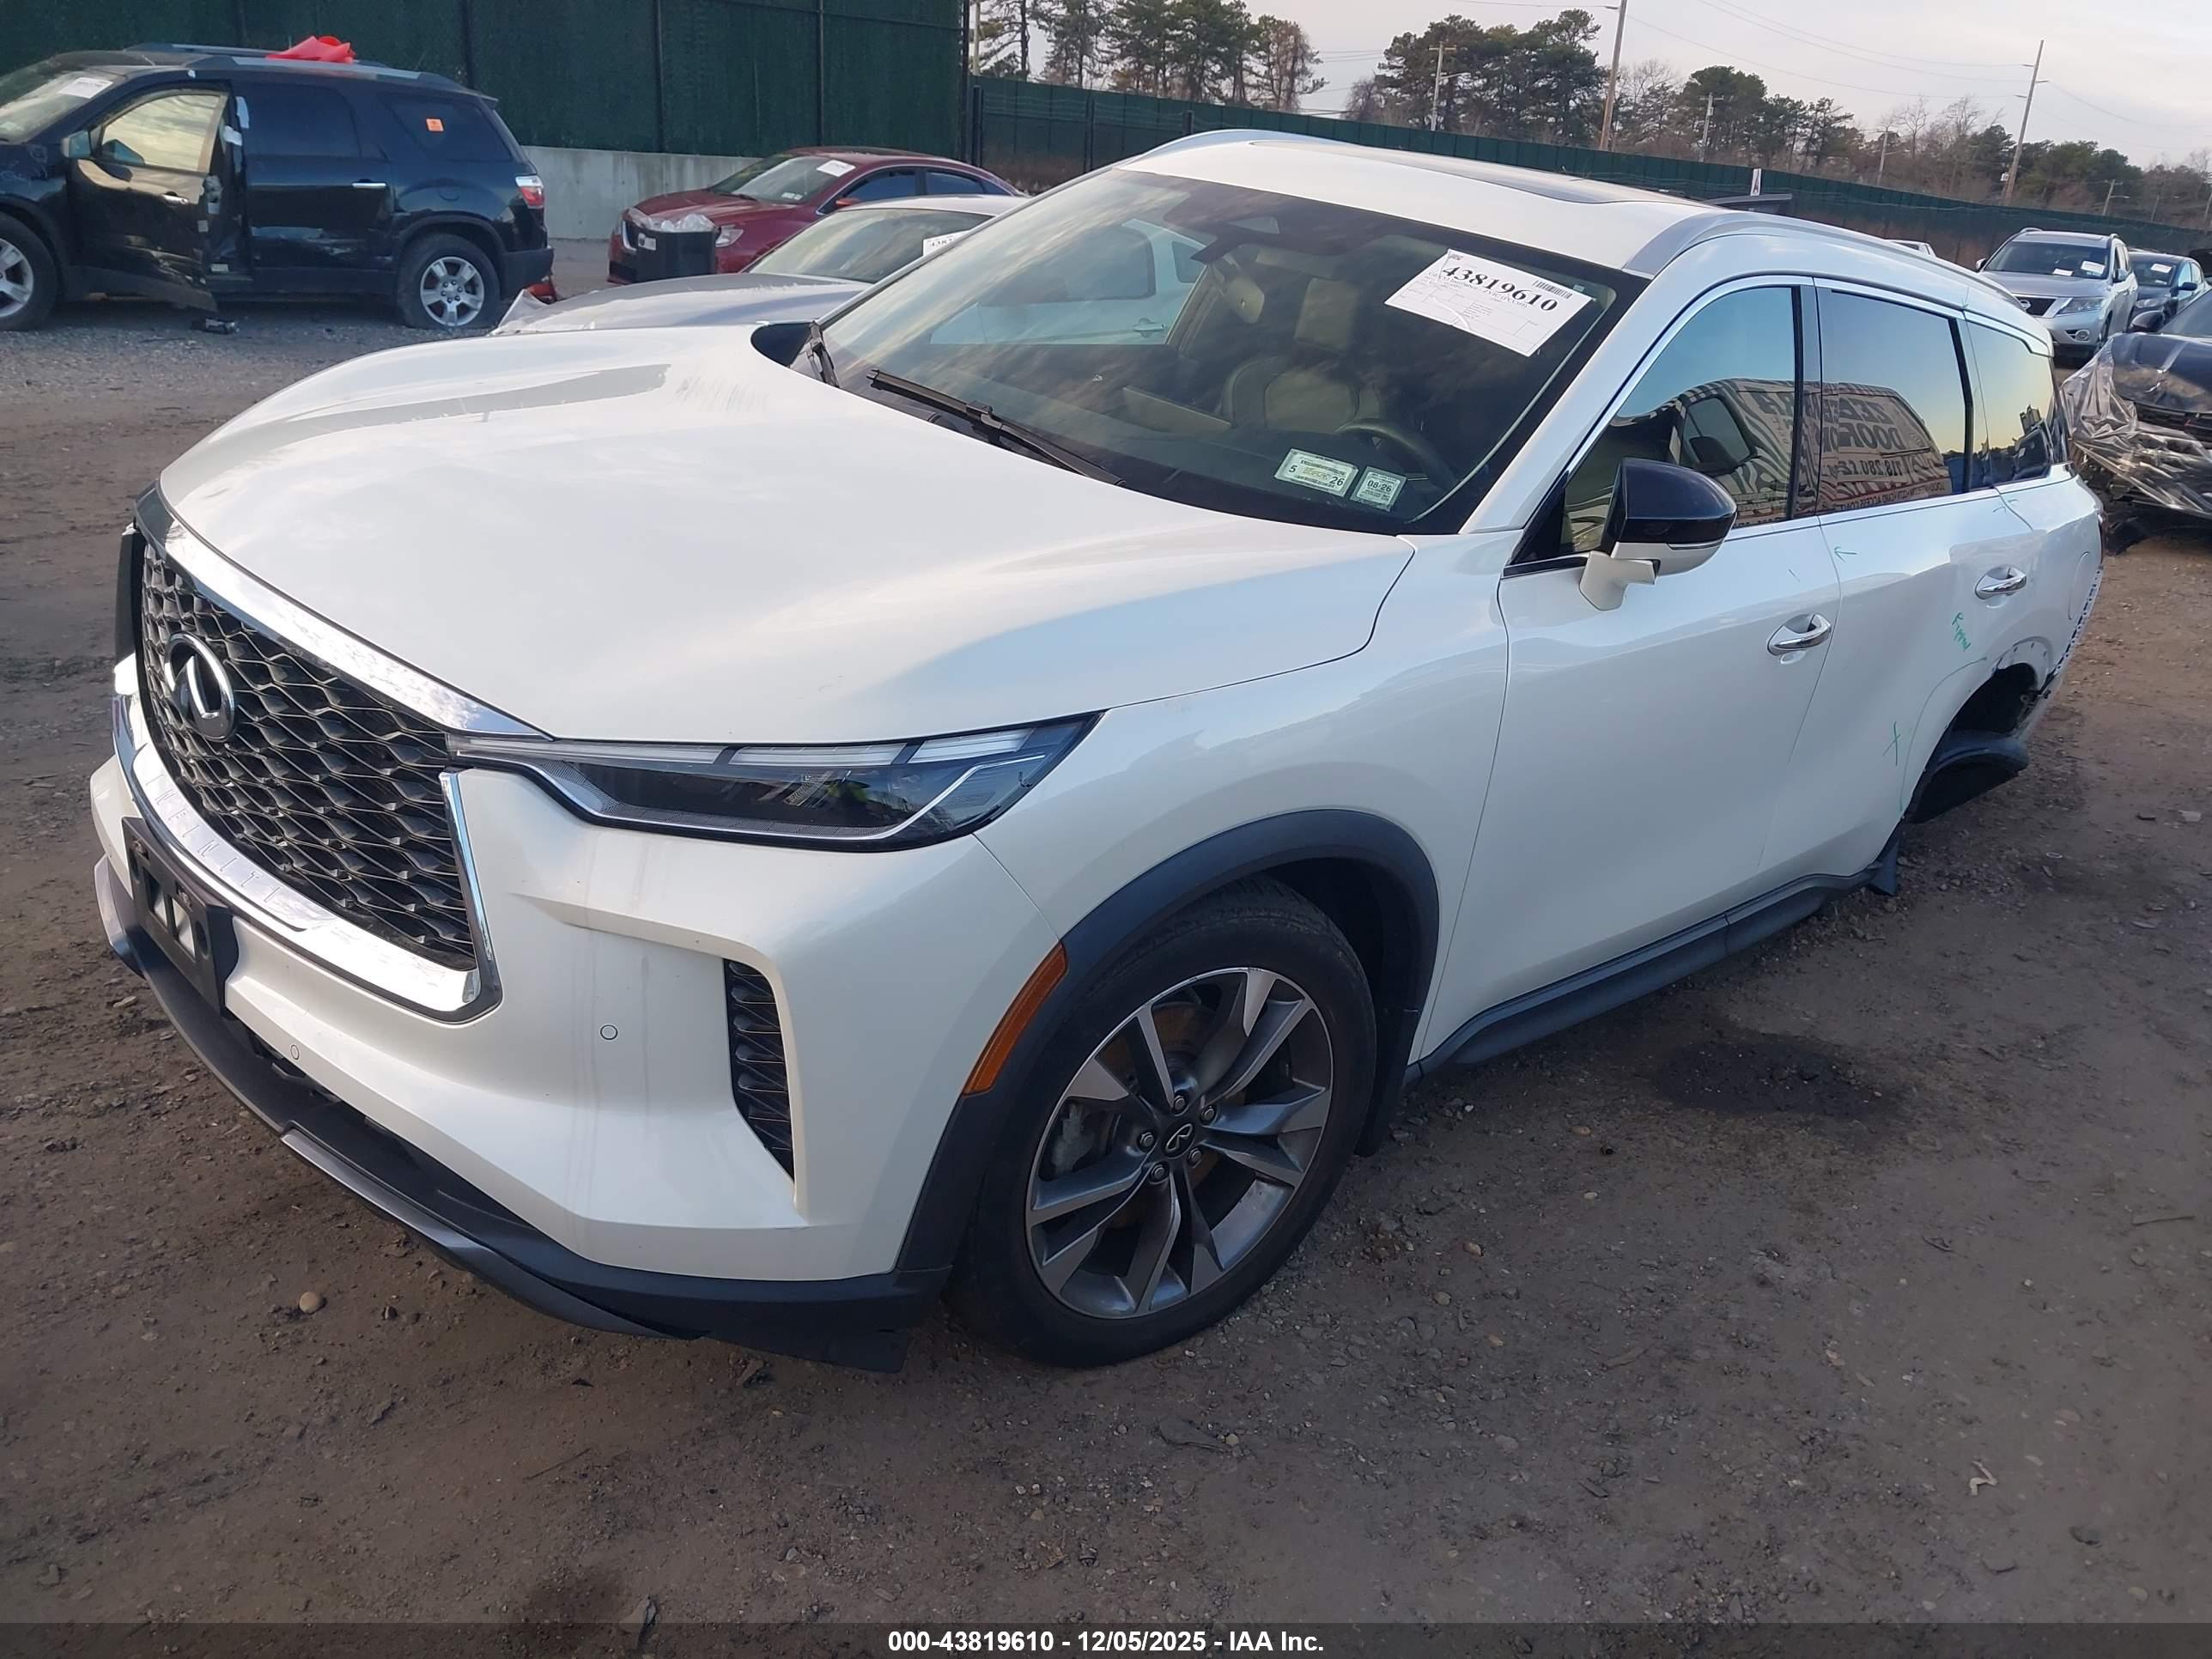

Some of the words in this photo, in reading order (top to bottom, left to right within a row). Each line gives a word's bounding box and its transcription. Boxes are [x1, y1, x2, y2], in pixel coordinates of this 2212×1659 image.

[1443, 265, 1559, 312] 43819610
[1289, 465, 1297, 473] 5
[1330, 476, 1346, 487] 26
[146, 772, 281, 903] INFINITI
